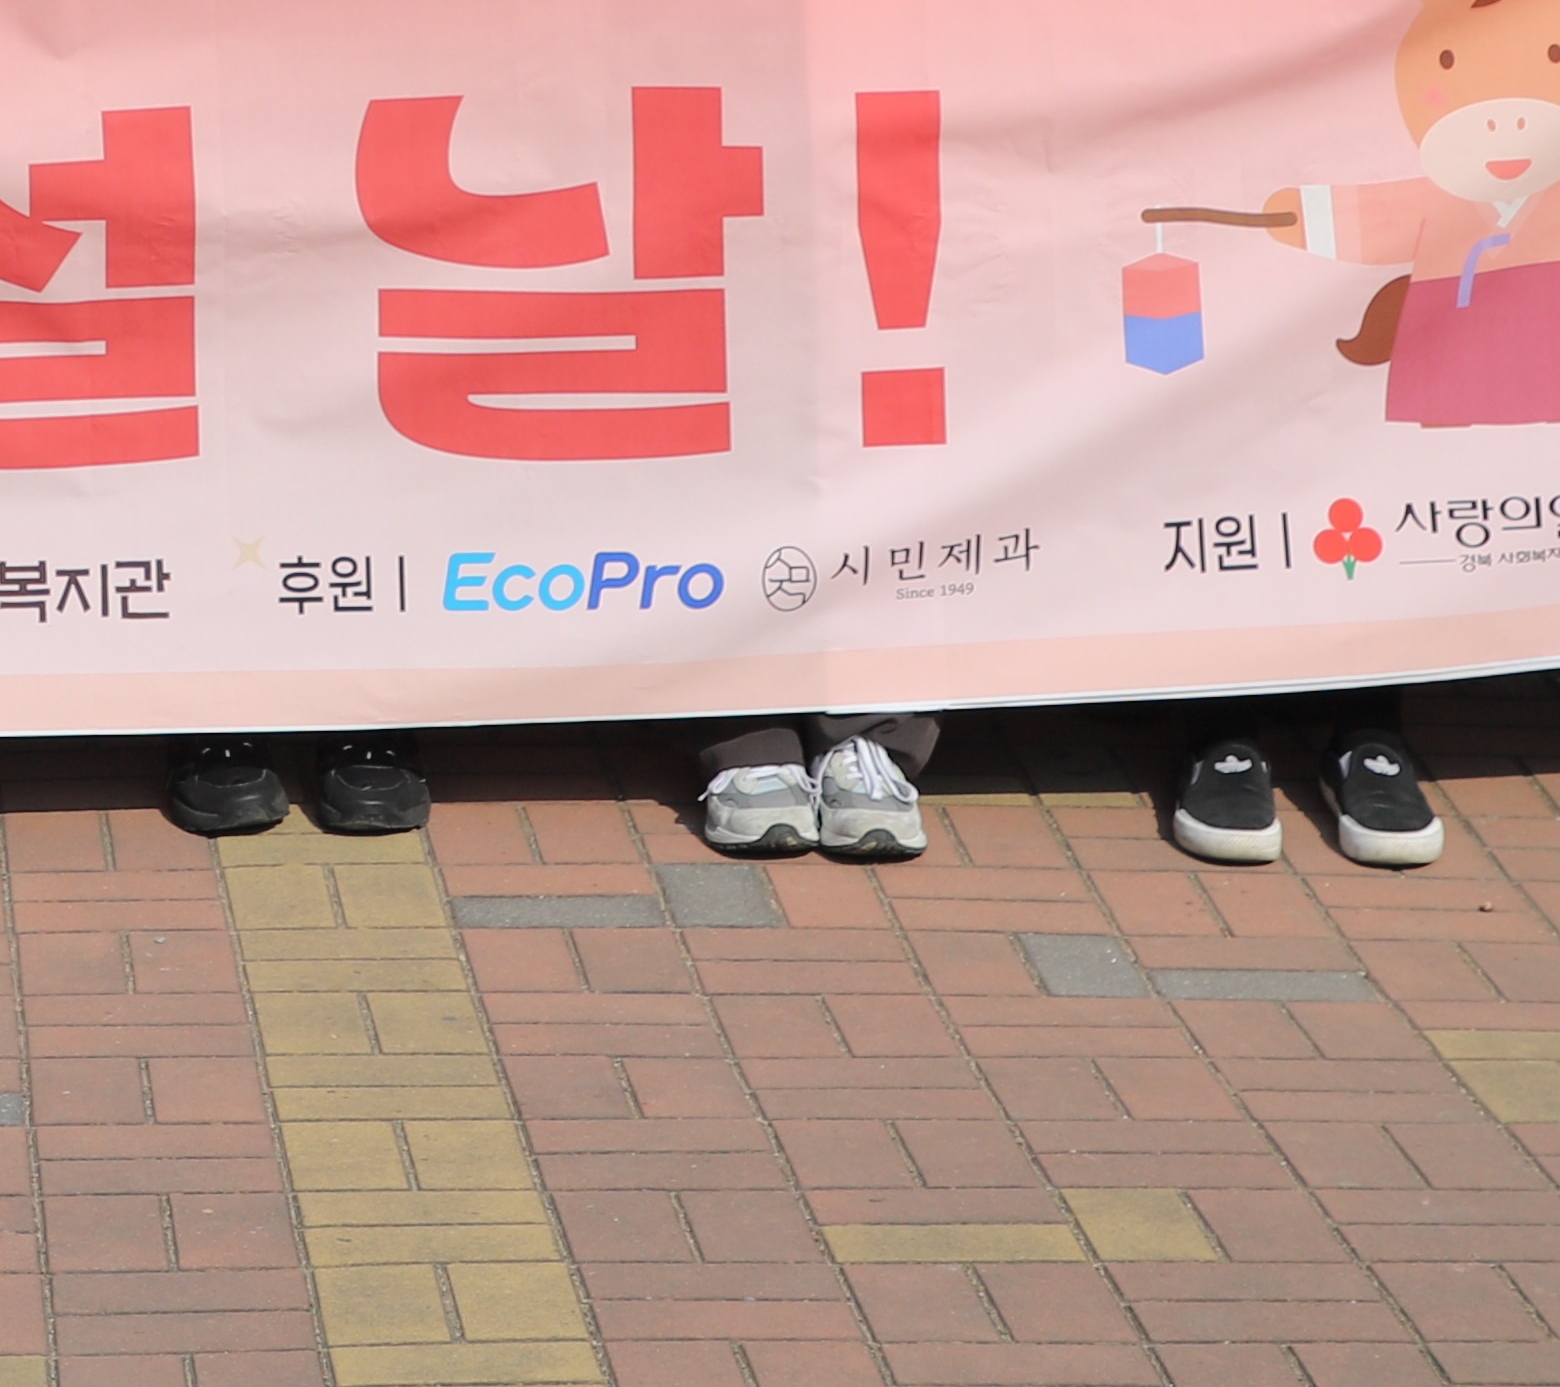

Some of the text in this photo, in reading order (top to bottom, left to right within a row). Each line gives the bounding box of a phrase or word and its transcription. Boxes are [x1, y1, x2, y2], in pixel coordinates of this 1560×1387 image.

[355, 86, 946, 461] 날!
[830, 526, 1042, 587] 시민제과
[1163, 512, 1260, 574] 지원
[1460, 552, 1493, 573] 경북
[278, 554, 376, 615] 후원
[440, 550, 726, 613] EcoPro
[895, 581, 975, 602] Since 1949
